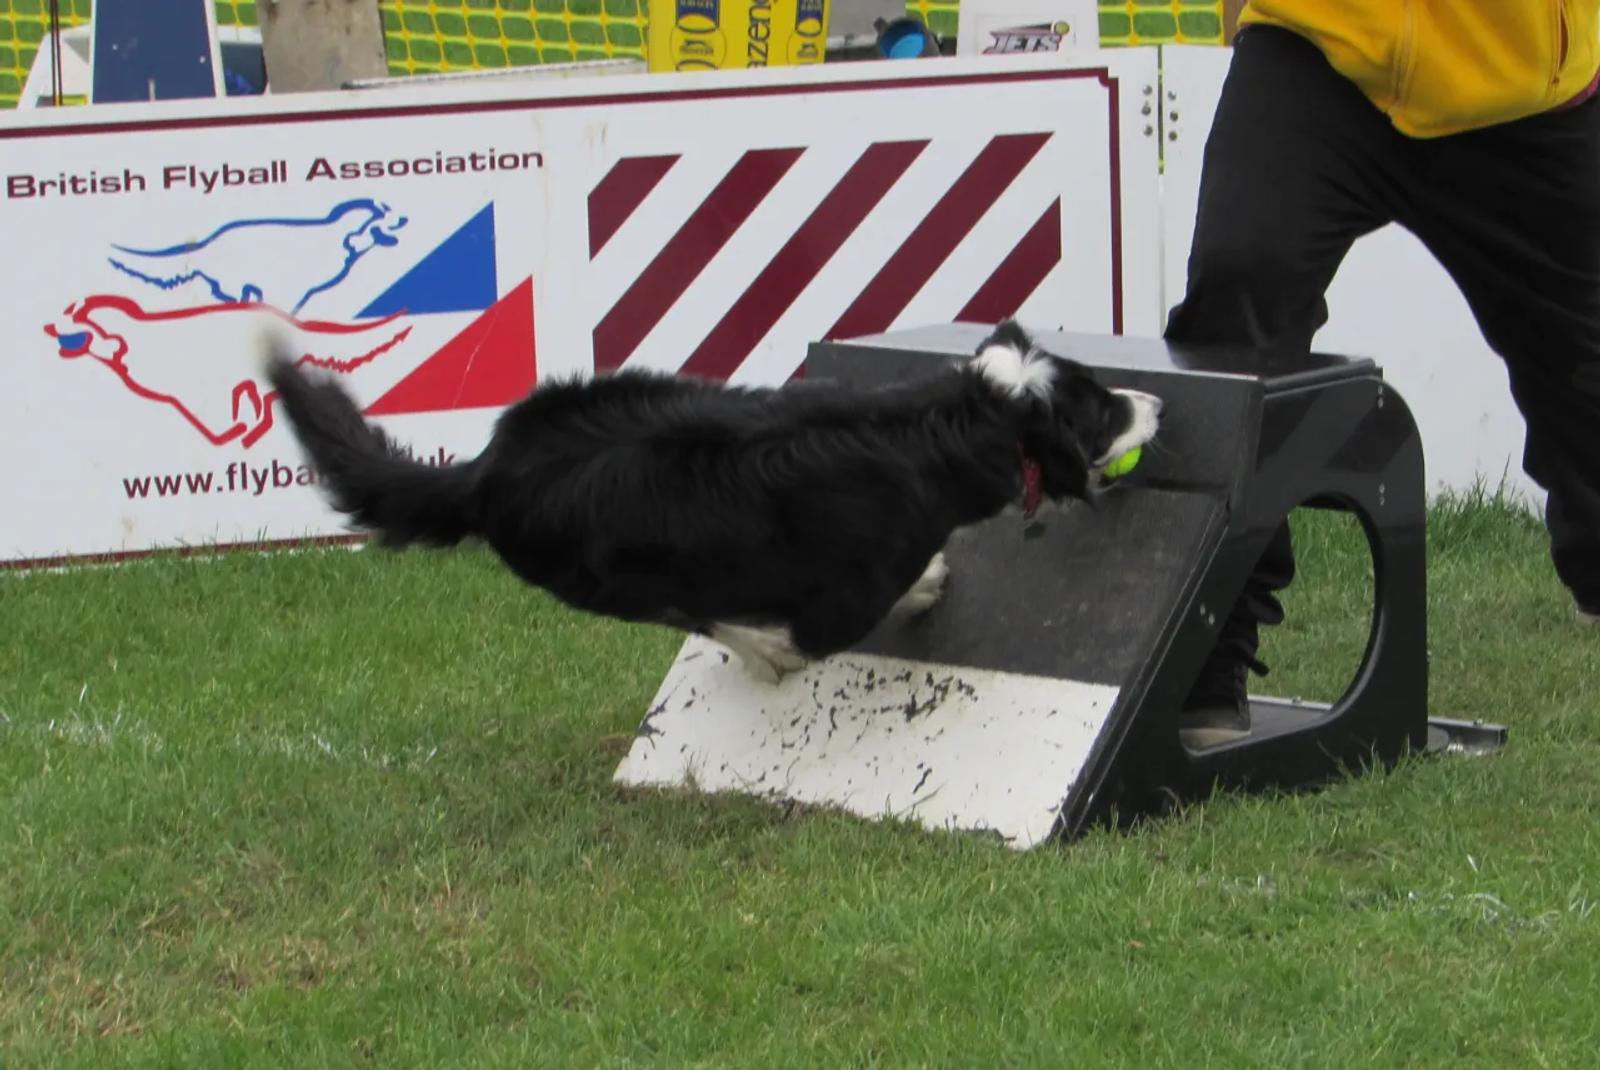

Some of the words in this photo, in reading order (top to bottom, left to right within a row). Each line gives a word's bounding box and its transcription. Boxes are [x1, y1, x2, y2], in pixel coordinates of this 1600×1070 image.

[982, 28, 1062, 55] JETS
[6, 168, 147, 199] British
[162, 158, 288, 195] Flyball
[305, 147, 544, 182] Association
